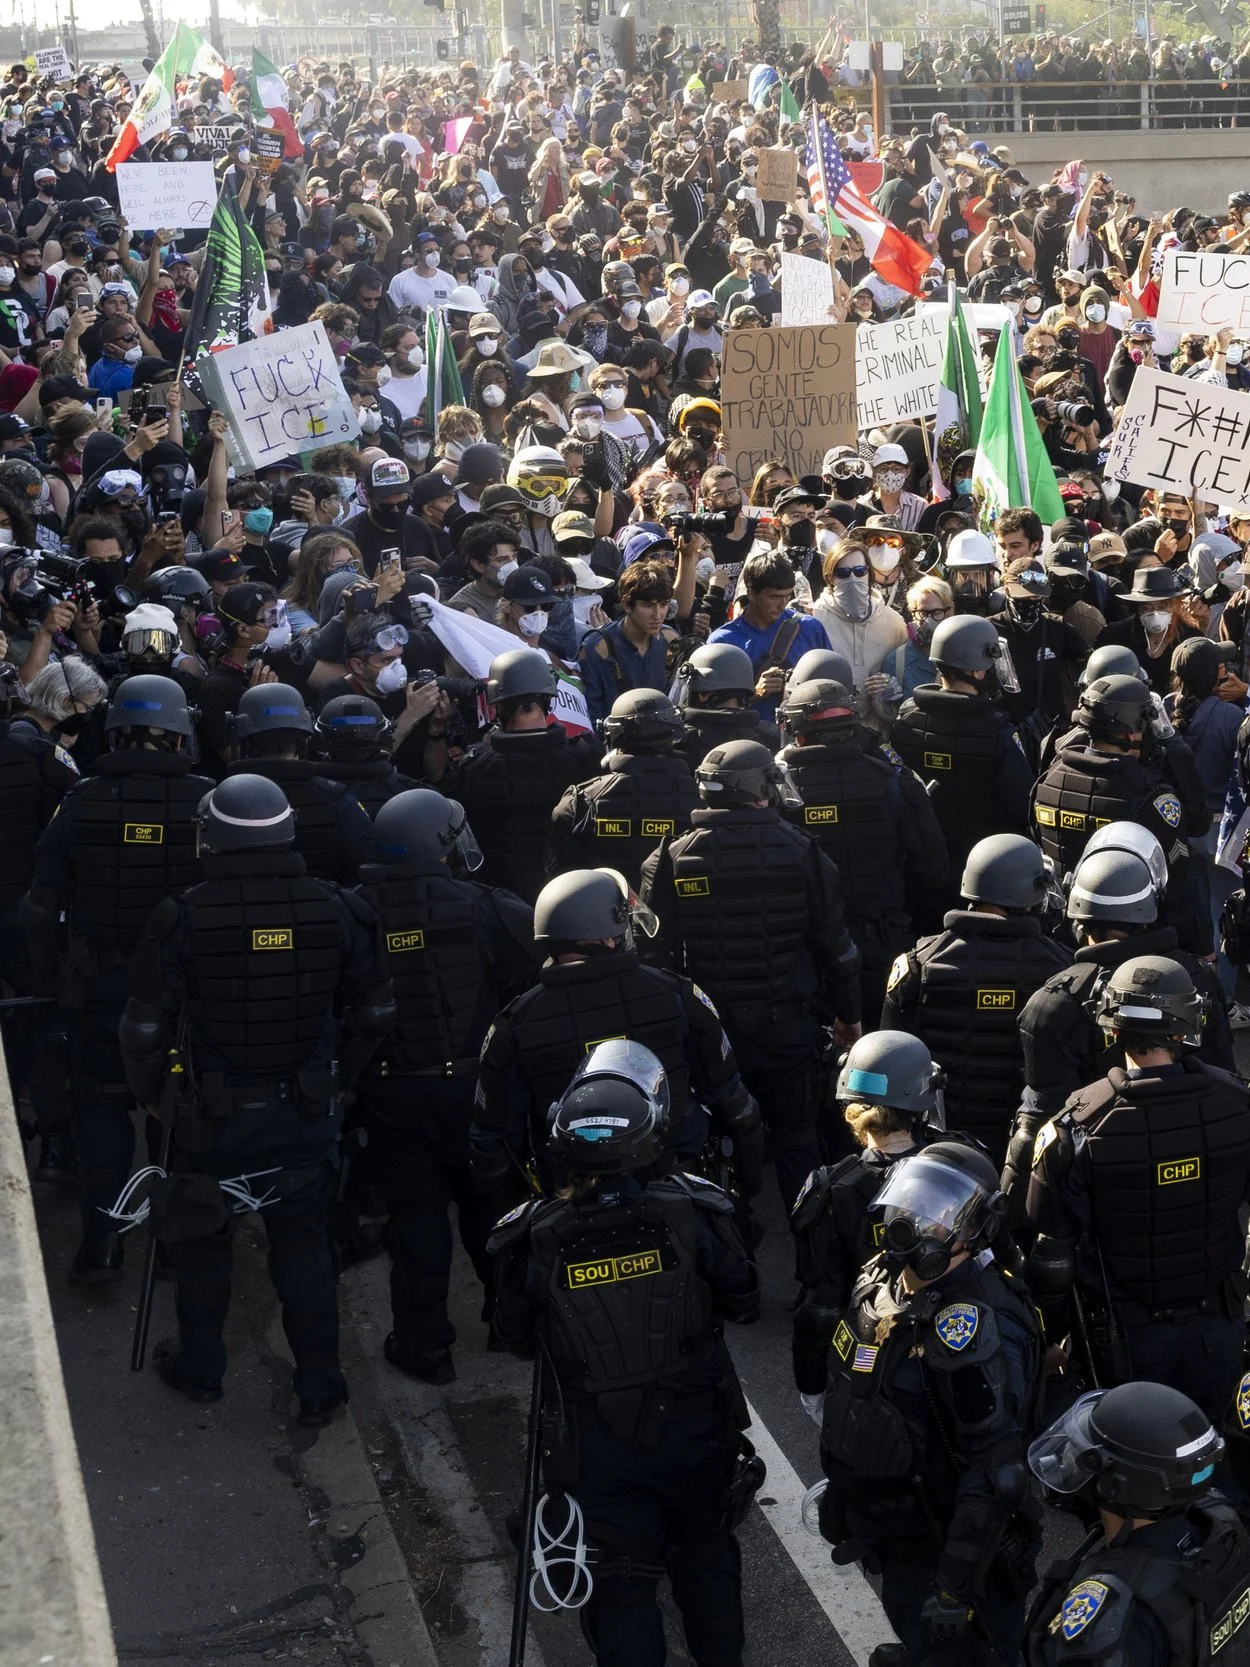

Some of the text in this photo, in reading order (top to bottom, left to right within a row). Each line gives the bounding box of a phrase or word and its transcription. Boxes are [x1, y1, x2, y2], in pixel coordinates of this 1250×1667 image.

[52, 54, 64, 62] THE
[158, 166, 188, 177] BEEN
[121, 181, 184, 194] HERE AND
[153, 195, 187, 206] ALWAYS
[150, 210, 179, 221] HERE
[859, 316, 942, 353] HE REAL
[229, 349, 337, 410] FUCK
[750, 371, 815, 400] GENTE
[723, 391, 857, 430] TRABAJADORA
[857, 384, 939, 425] THE WHITE
[245, 402, 333, 454] ICE
[773, 429, 804, 451] NO
[809, 810, 834, 820] CHP
[1062, 815, 1082, 827] CHP
[605, 823, 670, 833] INL CHP
[683, 881, 701, 892] INL
[258, 934, 288, 946] CHP
[392, 935, 420, 948] CHP
[982, 994, 1010, 1006] CHP
[1163, 1163, 1195, 1179] CHP
[573, 1255, 656, 1282] SOU CHP
[1212, 1598, 1250, 1647] SOU CHP
